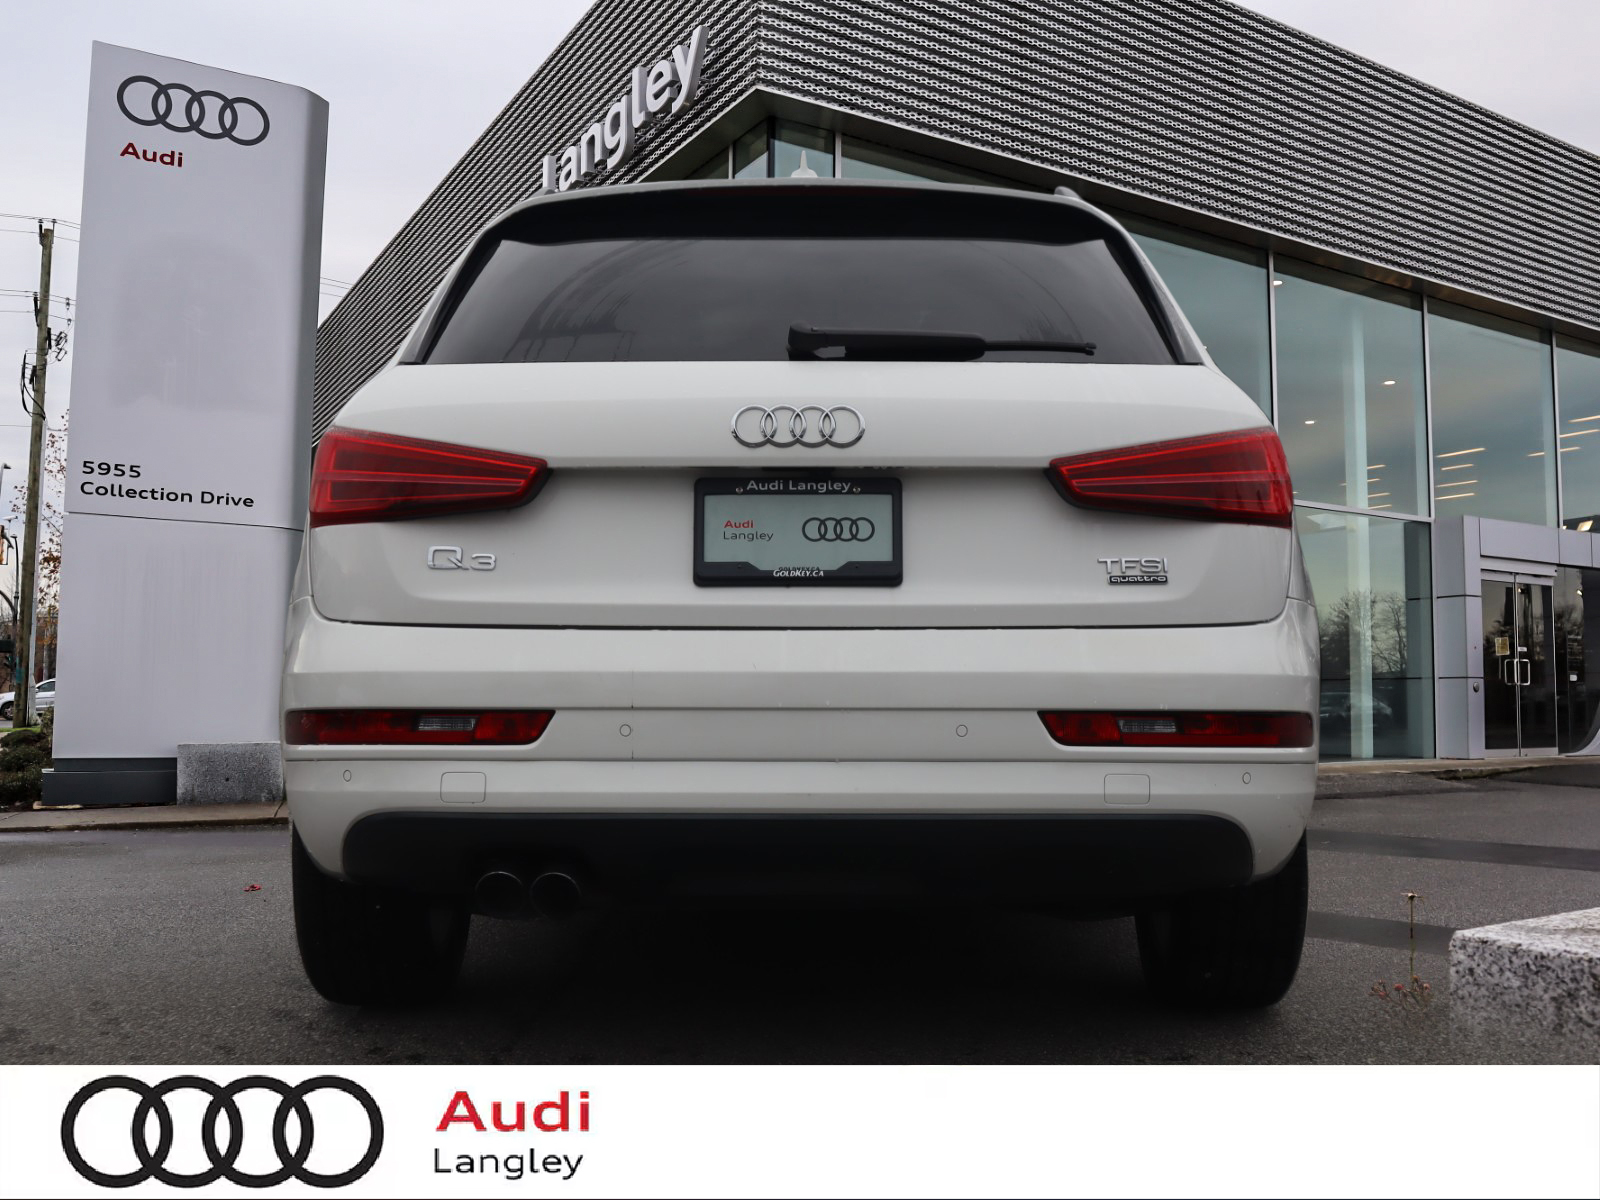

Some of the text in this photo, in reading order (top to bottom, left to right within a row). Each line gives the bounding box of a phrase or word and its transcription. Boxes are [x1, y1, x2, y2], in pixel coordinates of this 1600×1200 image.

[542, 25, 710, 192] Langley
[120, 142, 183, 168] Audi
[82, 460, 142, 478] 5955
[80, 481, 255, 508] Collection Drive
[746, 480, 851, 493] Audi Langley
[723, 520, 754, 529] Audi
[723, 531, 774, 542] Langley
[427, 545, 496, 571] Q3
[1098, 557, 1168, 573] TFSI
